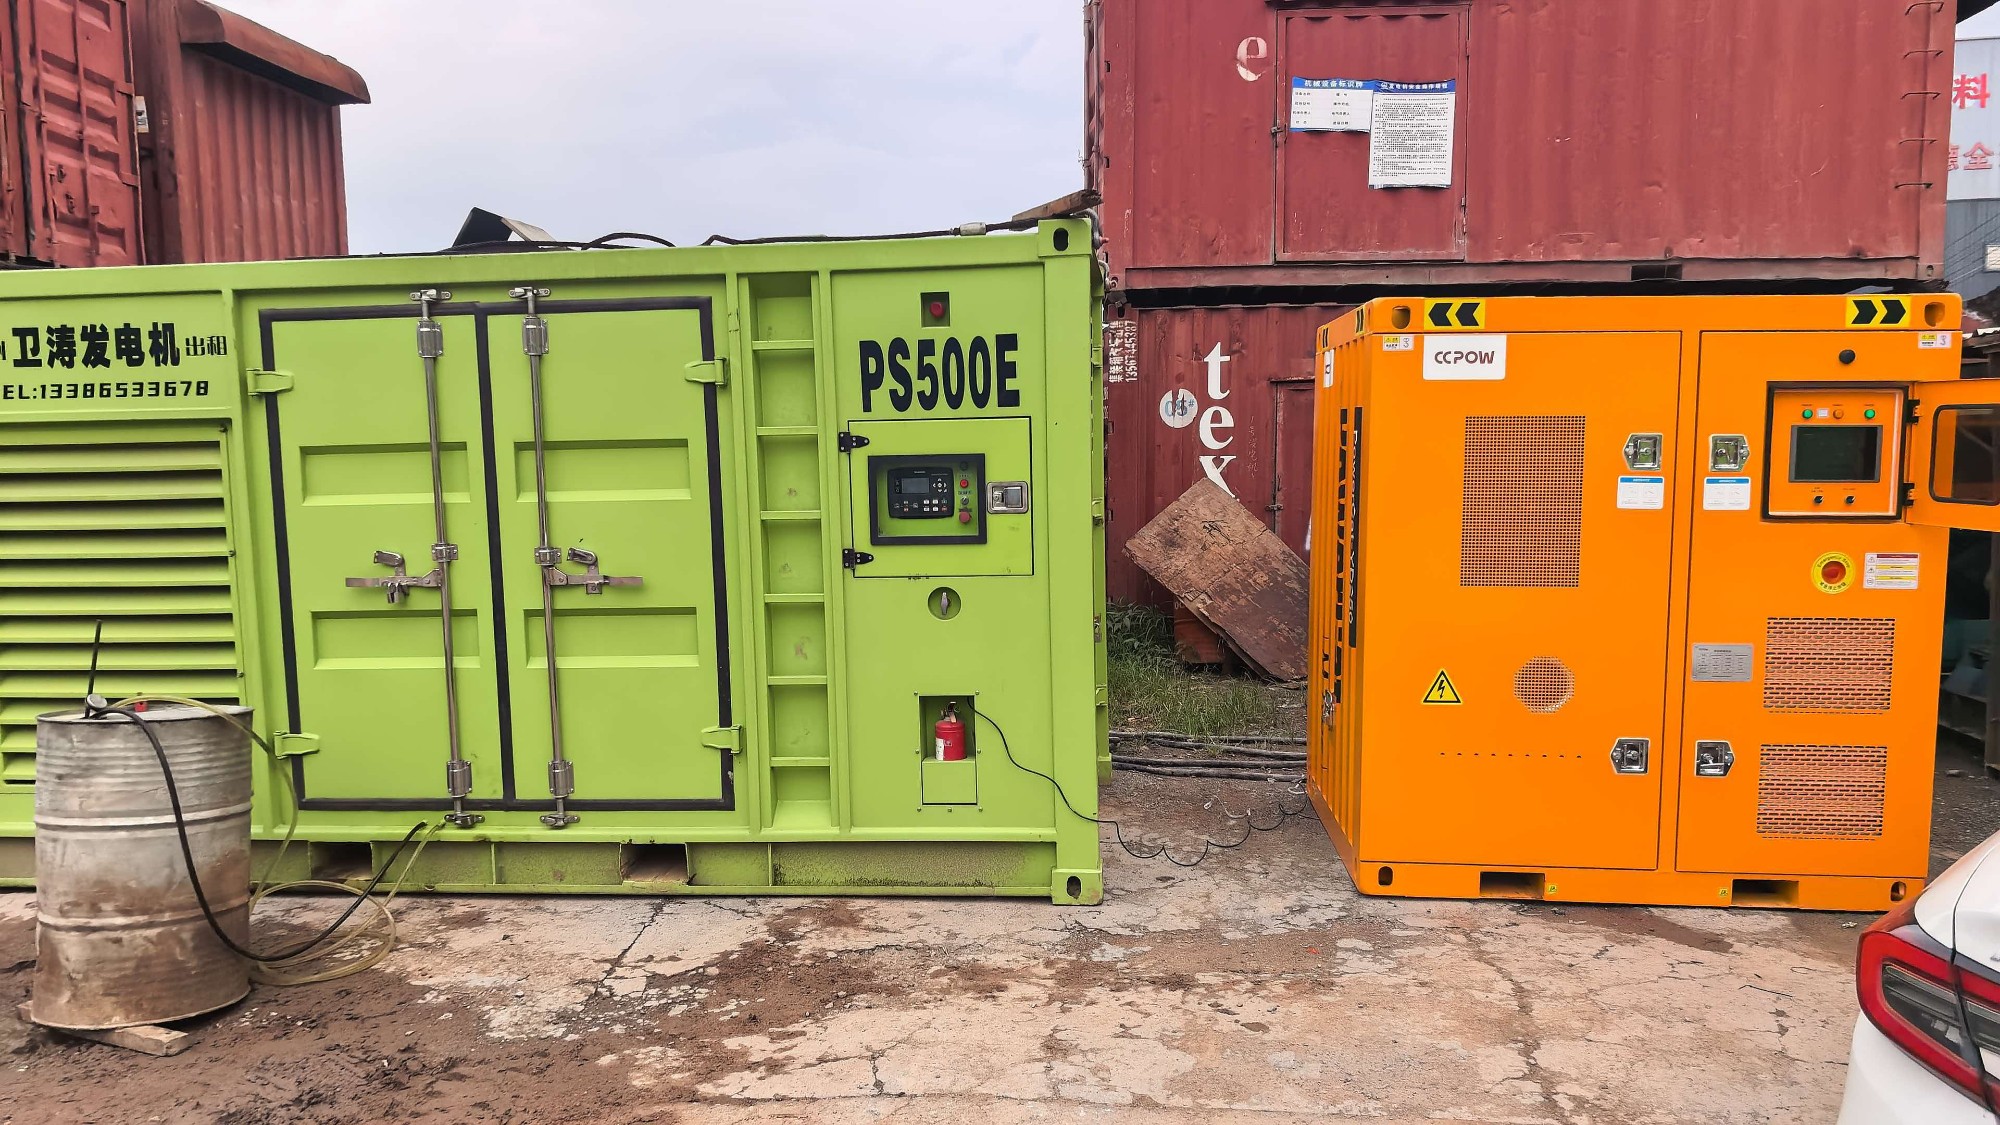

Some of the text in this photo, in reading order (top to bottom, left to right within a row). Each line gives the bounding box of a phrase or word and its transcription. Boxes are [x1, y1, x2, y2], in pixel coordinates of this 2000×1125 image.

[1236, 36, 1268, 82] e
[1952, 72, 1990, 110] 料
[859, 333, 1020, 413] PS500E
[1434, 350, 1495, 365] CCPOW
